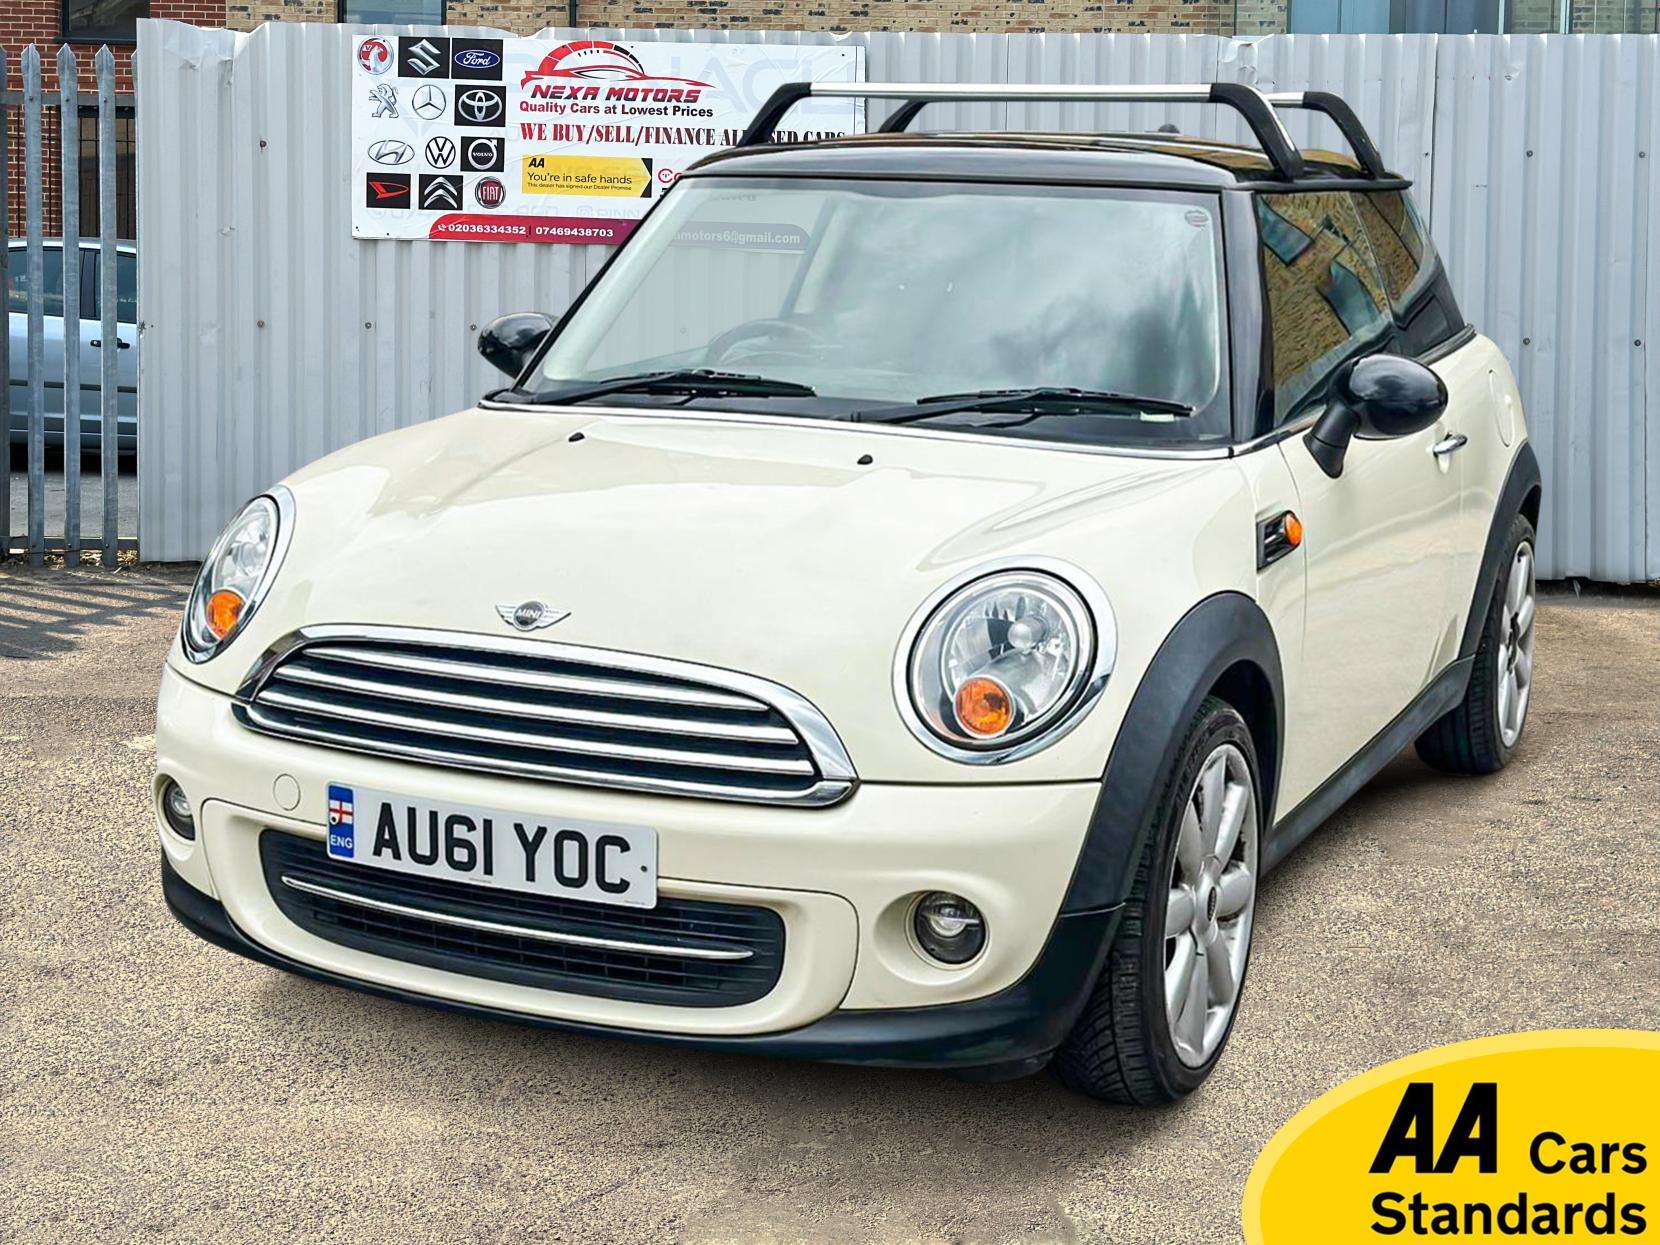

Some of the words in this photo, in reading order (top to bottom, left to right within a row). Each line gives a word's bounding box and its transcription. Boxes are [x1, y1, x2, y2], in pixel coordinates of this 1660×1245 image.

[463, 52, 491, 66] Ford
[531, 84, 600, 101] NEXA
[605, 87, 702, 104] MOTORS
[519, 101, 566, 115] Quality
[570, 103, 600, 114] Cars
[604, 104, 617, 114] at
[621, 104, 668, 116] Lowest
[672, 106, 714, 117] Prices
[520, 122, 547, 141] WE
[552, 123, 715, 146] BUY/SELL/FINANCE
[528, 157, 545, 168] AA
[528, 172, 560, 182] You're
[563, 173, 572, 182] in
[575, 173, 597, 183] safe
[600, 175, 632, 185] hands
[482, 186, 499, 201] FIAT
[448, 223, 526, 235] 02036334352
[535, 226, 614, 237] 07469438703
[517, 608, 541, 621] MINI
[330, 834, 353, 850] ENG
[372, 801, 494, 876] AU61
[514, 823, 631, 894] YOC
